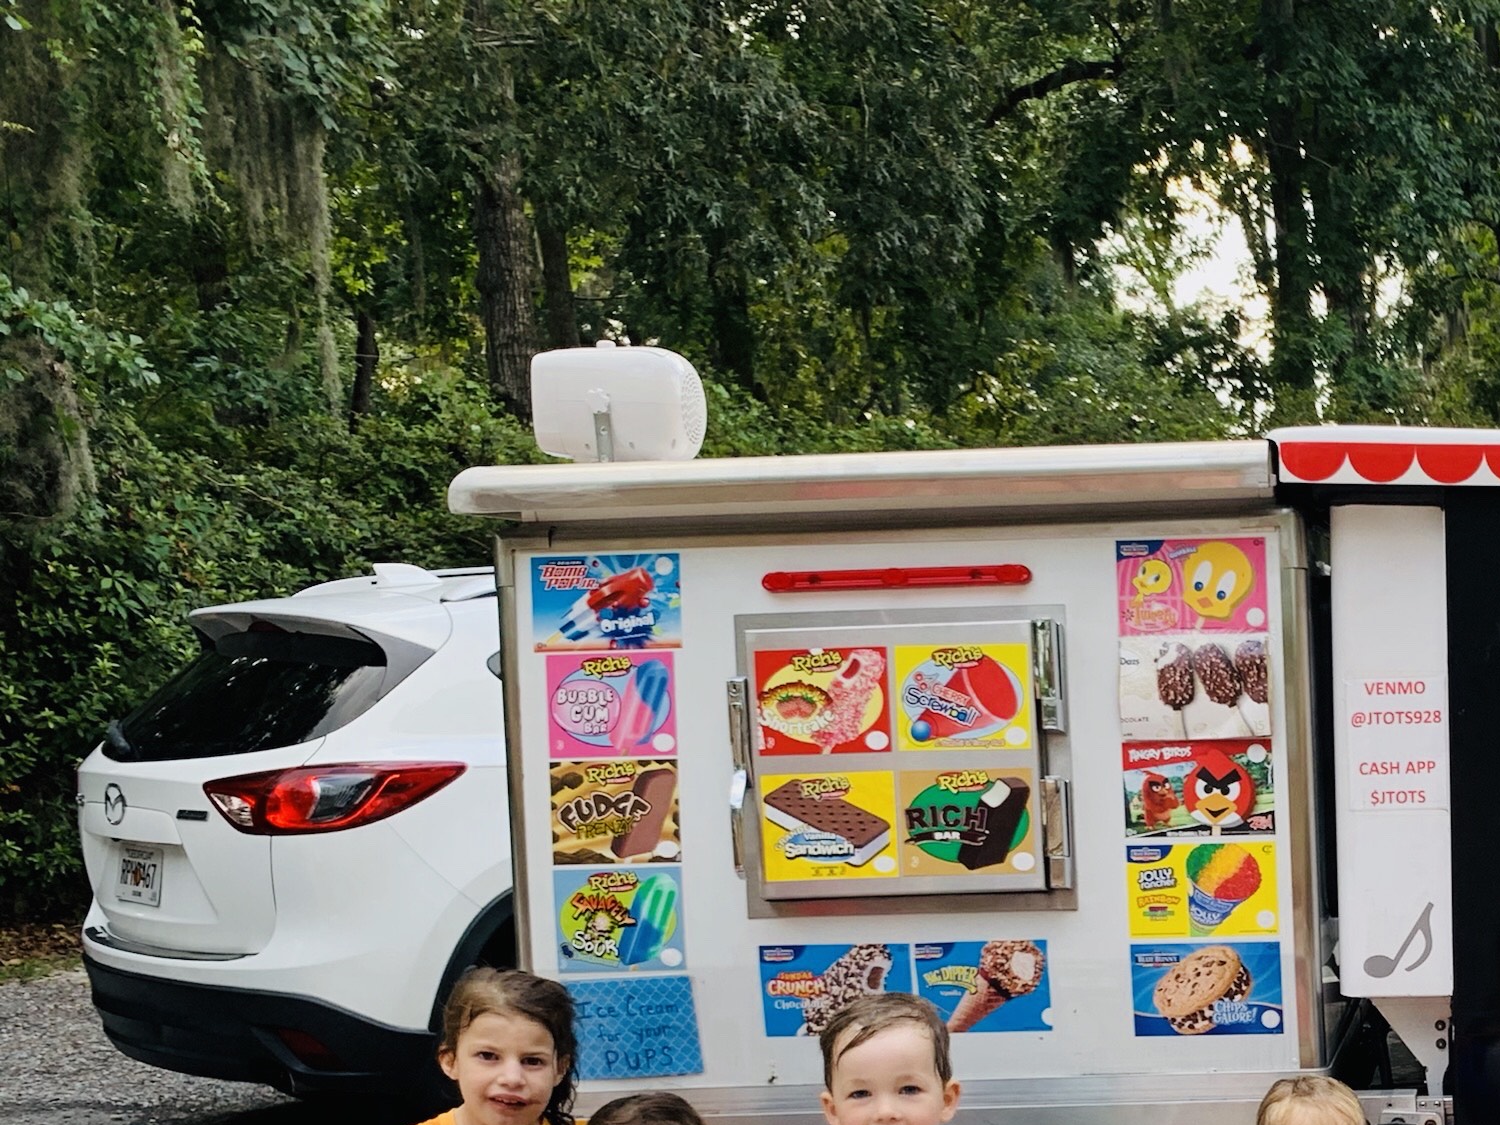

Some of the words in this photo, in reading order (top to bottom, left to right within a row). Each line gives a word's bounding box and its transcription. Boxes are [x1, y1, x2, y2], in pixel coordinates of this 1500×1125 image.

[542, 565, 587, 578] BOMB
[545, 578, 580, 591] POP
[601, 612, 655, 633] Original
[583, 656, 632, 680] Rich's
[792, 651, 842, 676] Rich's
[932, 647, 983, 671] Rich's
[557, 688, 614, 705] BUBBLE
[932, 683, 974, 707] CHERRY
[1364, 681, 1426, 695] VENMO
[570, 703, 609, 723] GUM
[904, 686, 982, 728] Screwball
[584, 722, 608, 735] BAR
[1351, 710, 1442, 728] @JTOTS928
[1128, 748, 1161, 762] ANGRY
[1162, 746, 1193, 760] BIRDS
[586, 762, 636, 786] Rich's
[1359, 762, 1400, 775] CASH
[1405, 761, 1436, 774] APP
[801, 777, 850, 802] Rich's
[938, 770, 989, 794] Rich's
[1371, 790, 1426, 806] $JTOTS
[557, 791, 652, 834] FUDGE
[905, 804, 988, 832] RICH
[576, 816, 634, 840] FRENZY
[933, 831, 961, 840] BAR
[785, 842, 855, 860] Sandwich
[589, 870, 638, 894] Rich's
[1138, 868, 1174, 884] JOLLY
[571, 892, 637, 928] SAVAGELY
[572, 930, 619, 958] SOUR
[767, 979, 826, 997] CRUNCH
[575, 1001, 618, 1020] Ice
[624, 995, 679, 1017] Cream
[1212, 1007, 1258, 1025] GALORE!
[1213, 1002, 1250, 1014] CHIPS
[597, 1023, 622, 1043] for
[632, 1023, 673, 1044] your
[605, 1046, 673, 1072] PUPS
